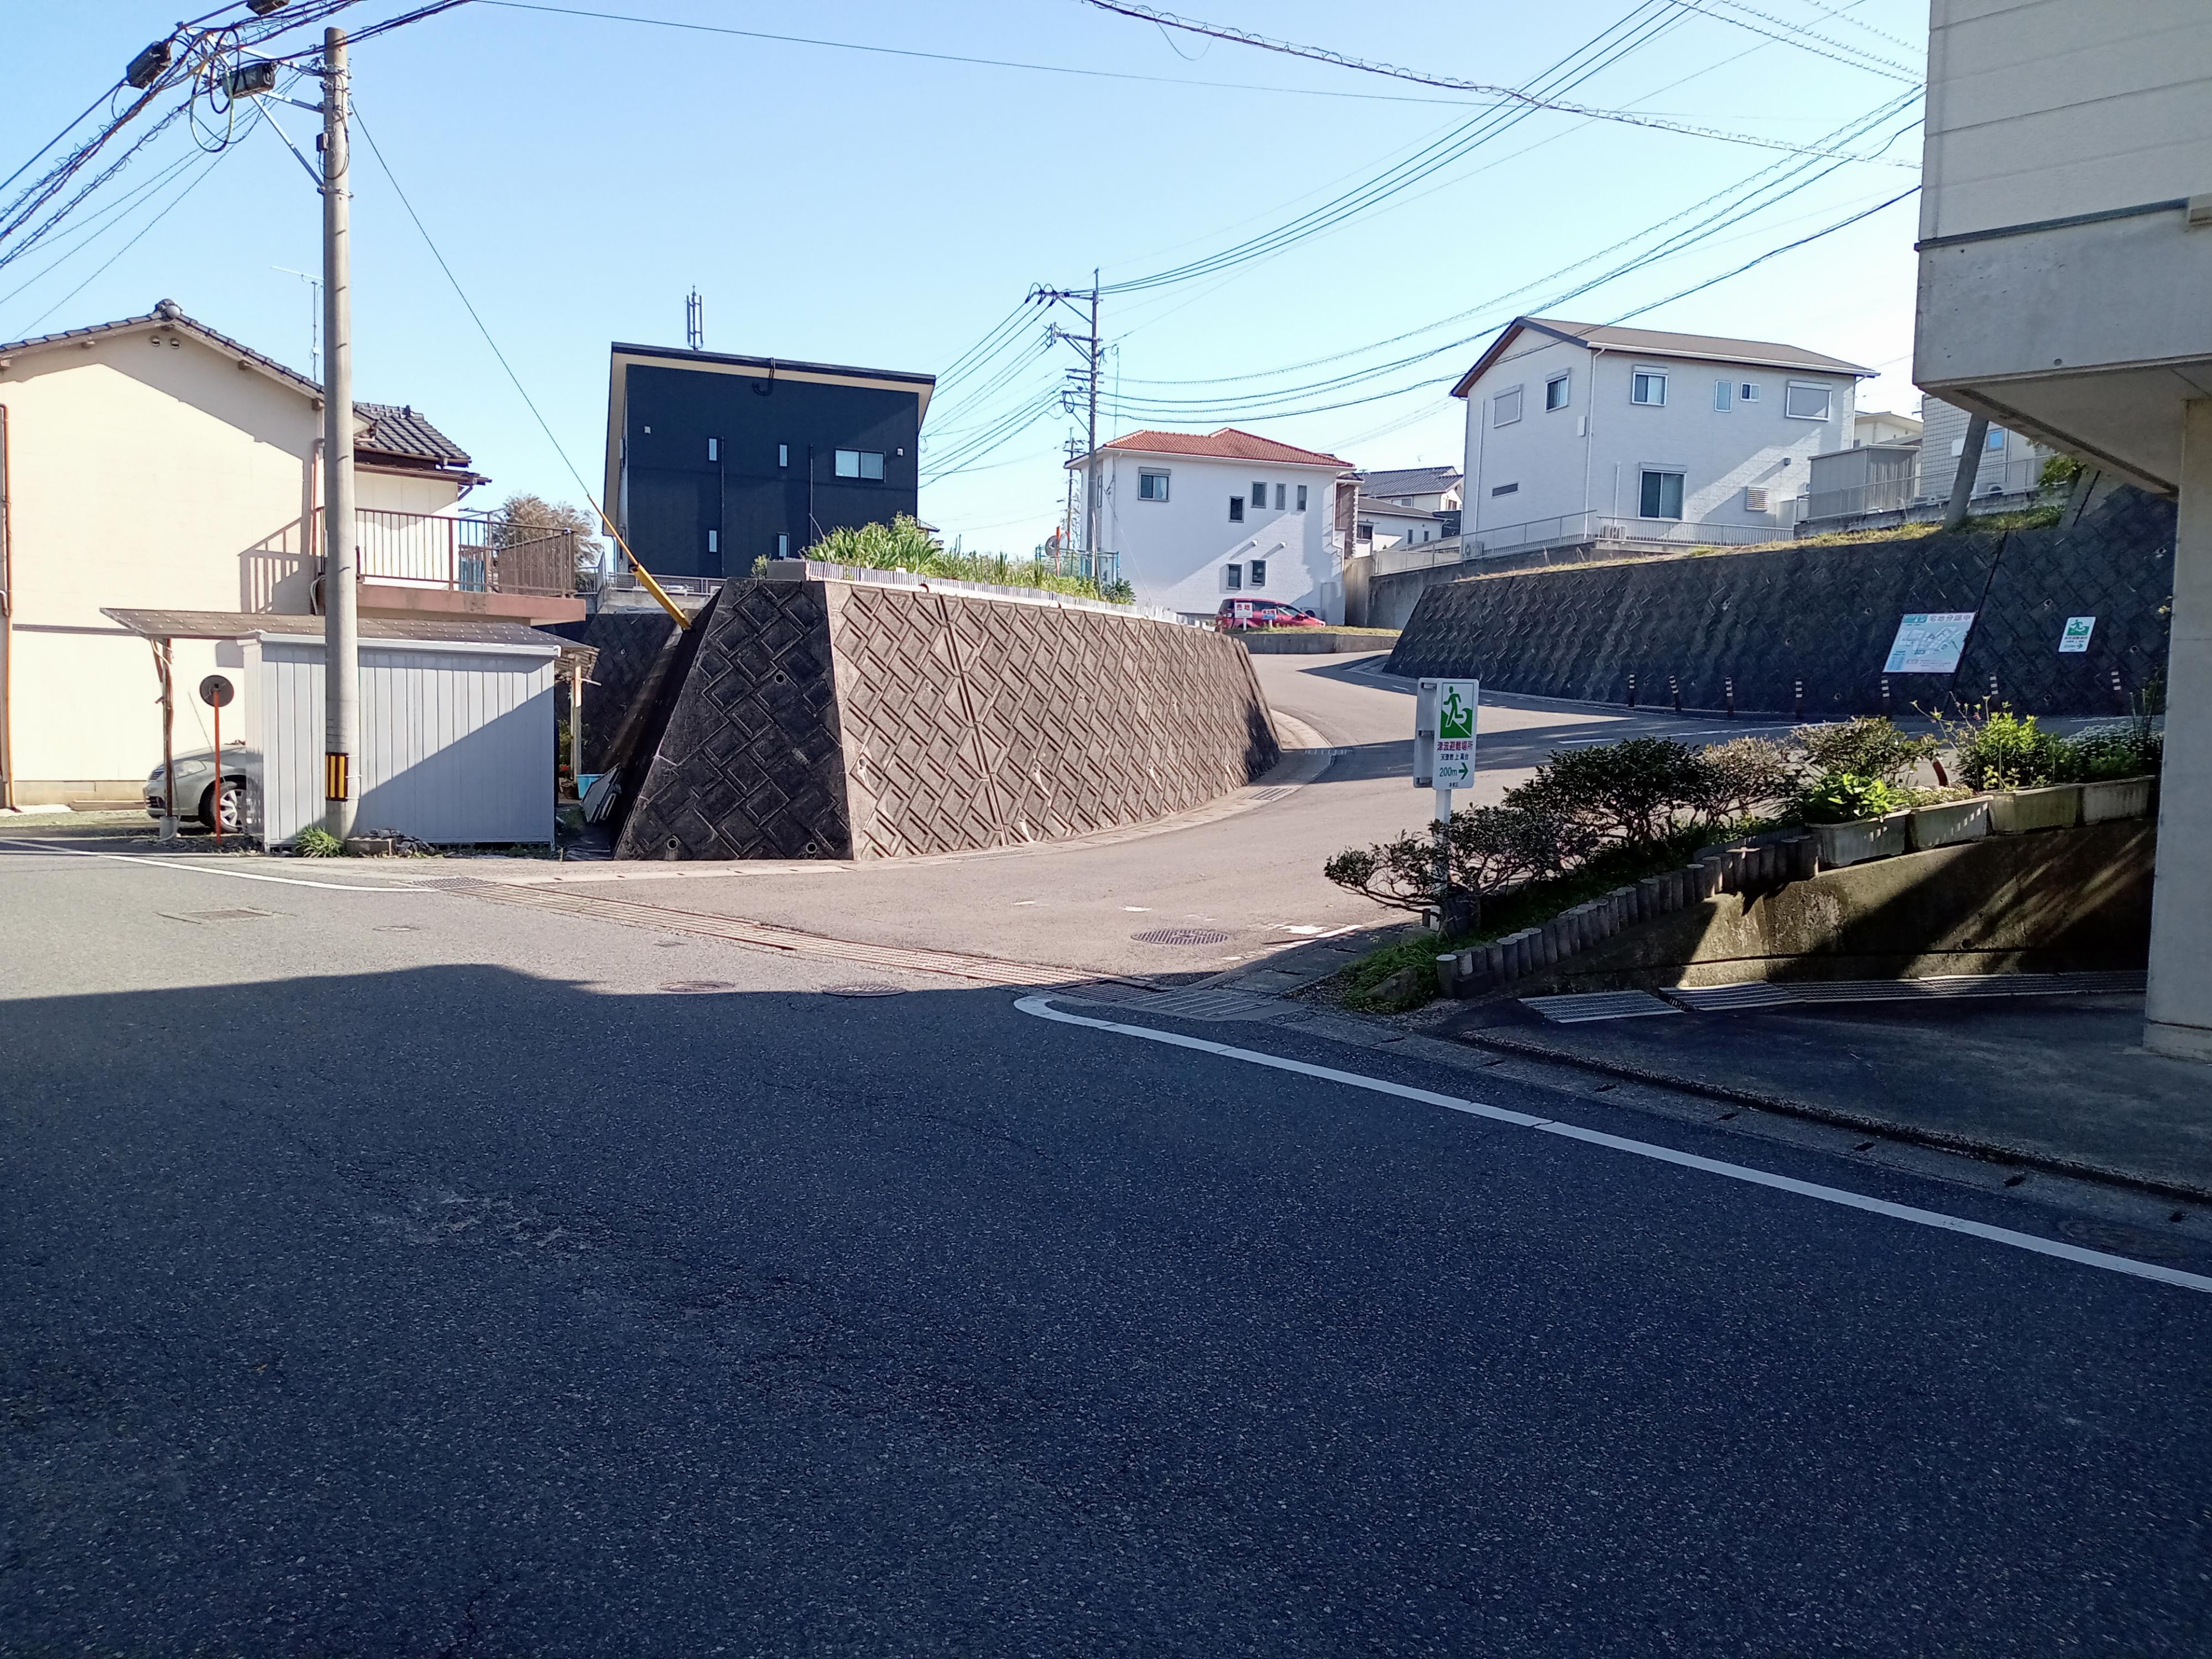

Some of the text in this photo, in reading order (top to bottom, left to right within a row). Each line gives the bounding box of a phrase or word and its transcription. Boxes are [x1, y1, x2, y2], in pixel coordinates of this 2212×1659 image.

[1437, 741, 1473, 751] 津波避難場所
[1439, 766, 1457, 777] 200m
